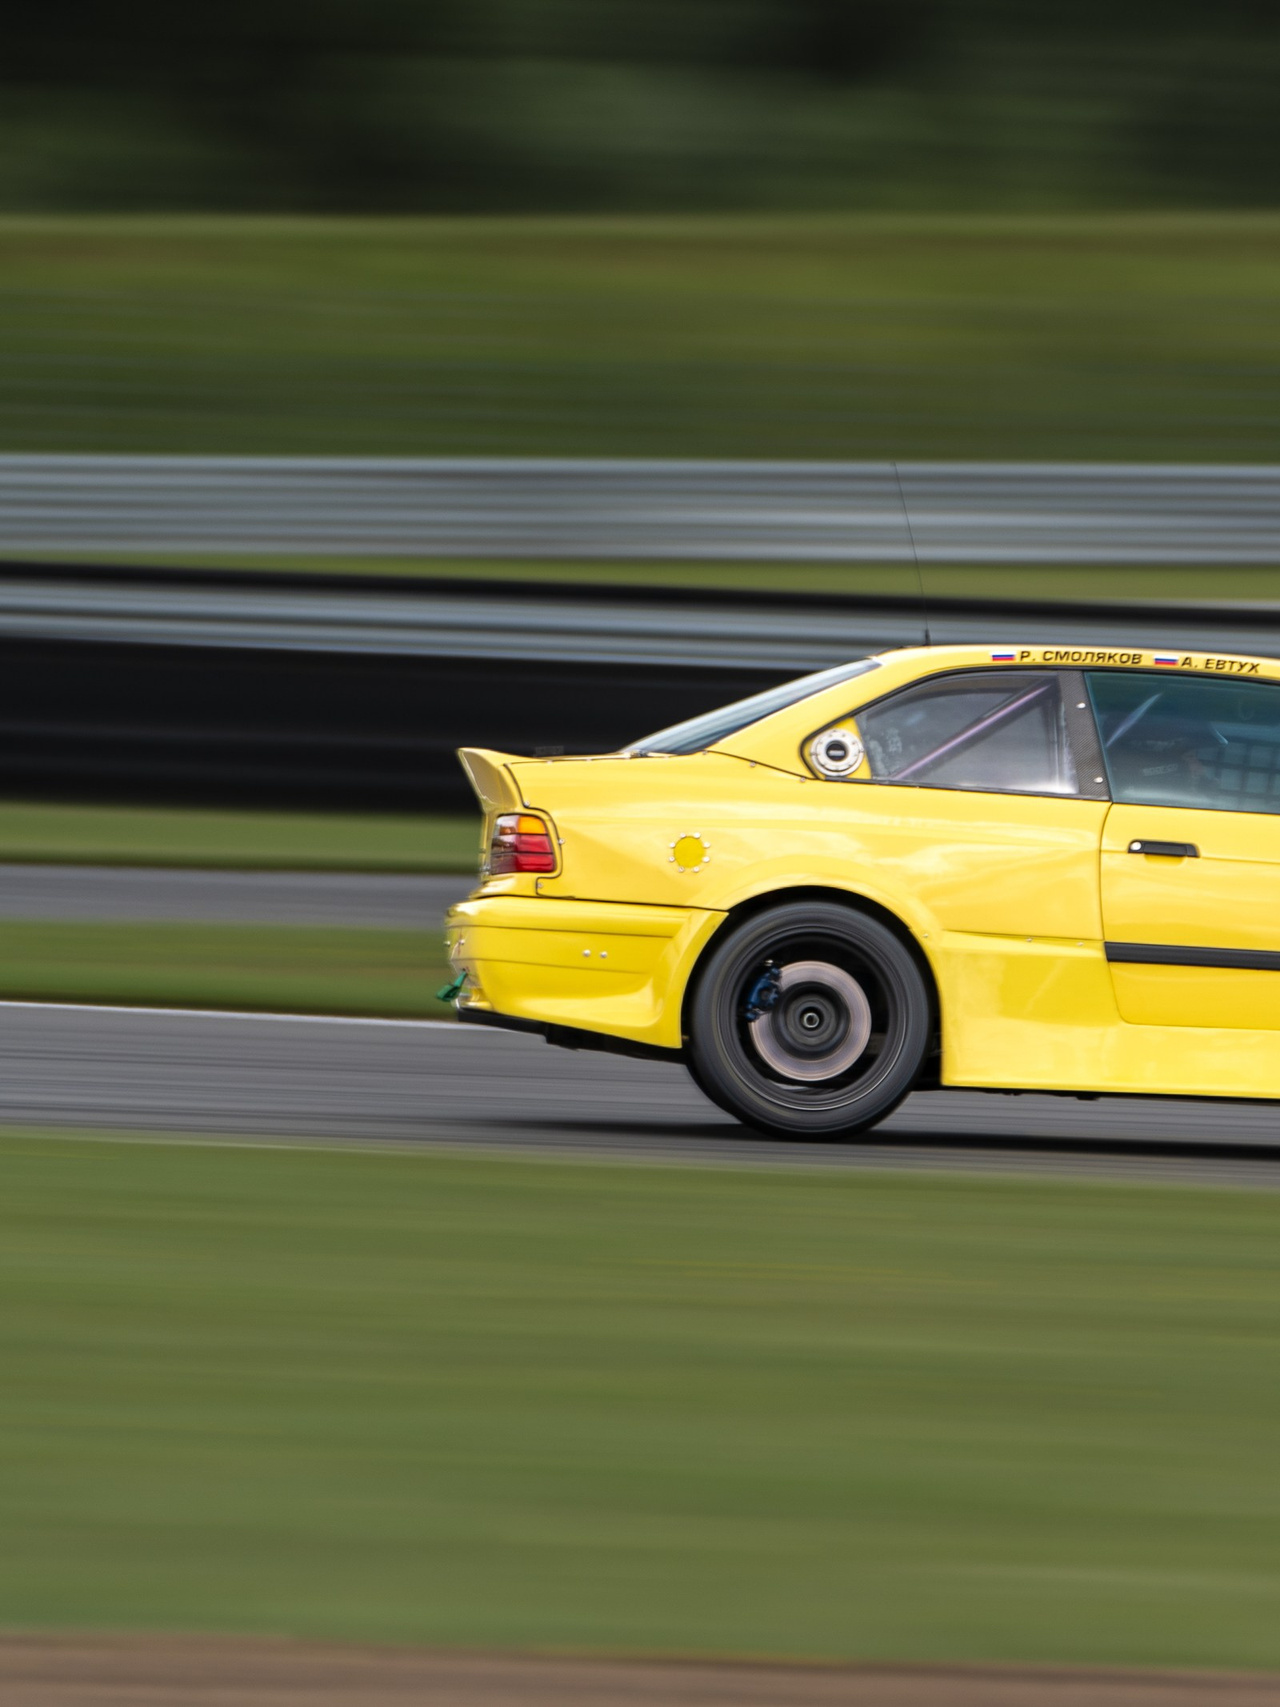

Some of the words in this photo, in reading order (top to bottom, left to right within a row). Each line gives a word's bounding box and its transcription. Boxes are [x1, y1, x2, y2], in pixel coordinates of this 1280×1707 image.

[1020, 650, 1036, 662] Р.
[1043, 650, 1142, 664] СМОЛЯКОВ
[1181, 657, 1198, 668] А.
[1205, 659, 1260, 673] ЕВТУХ
